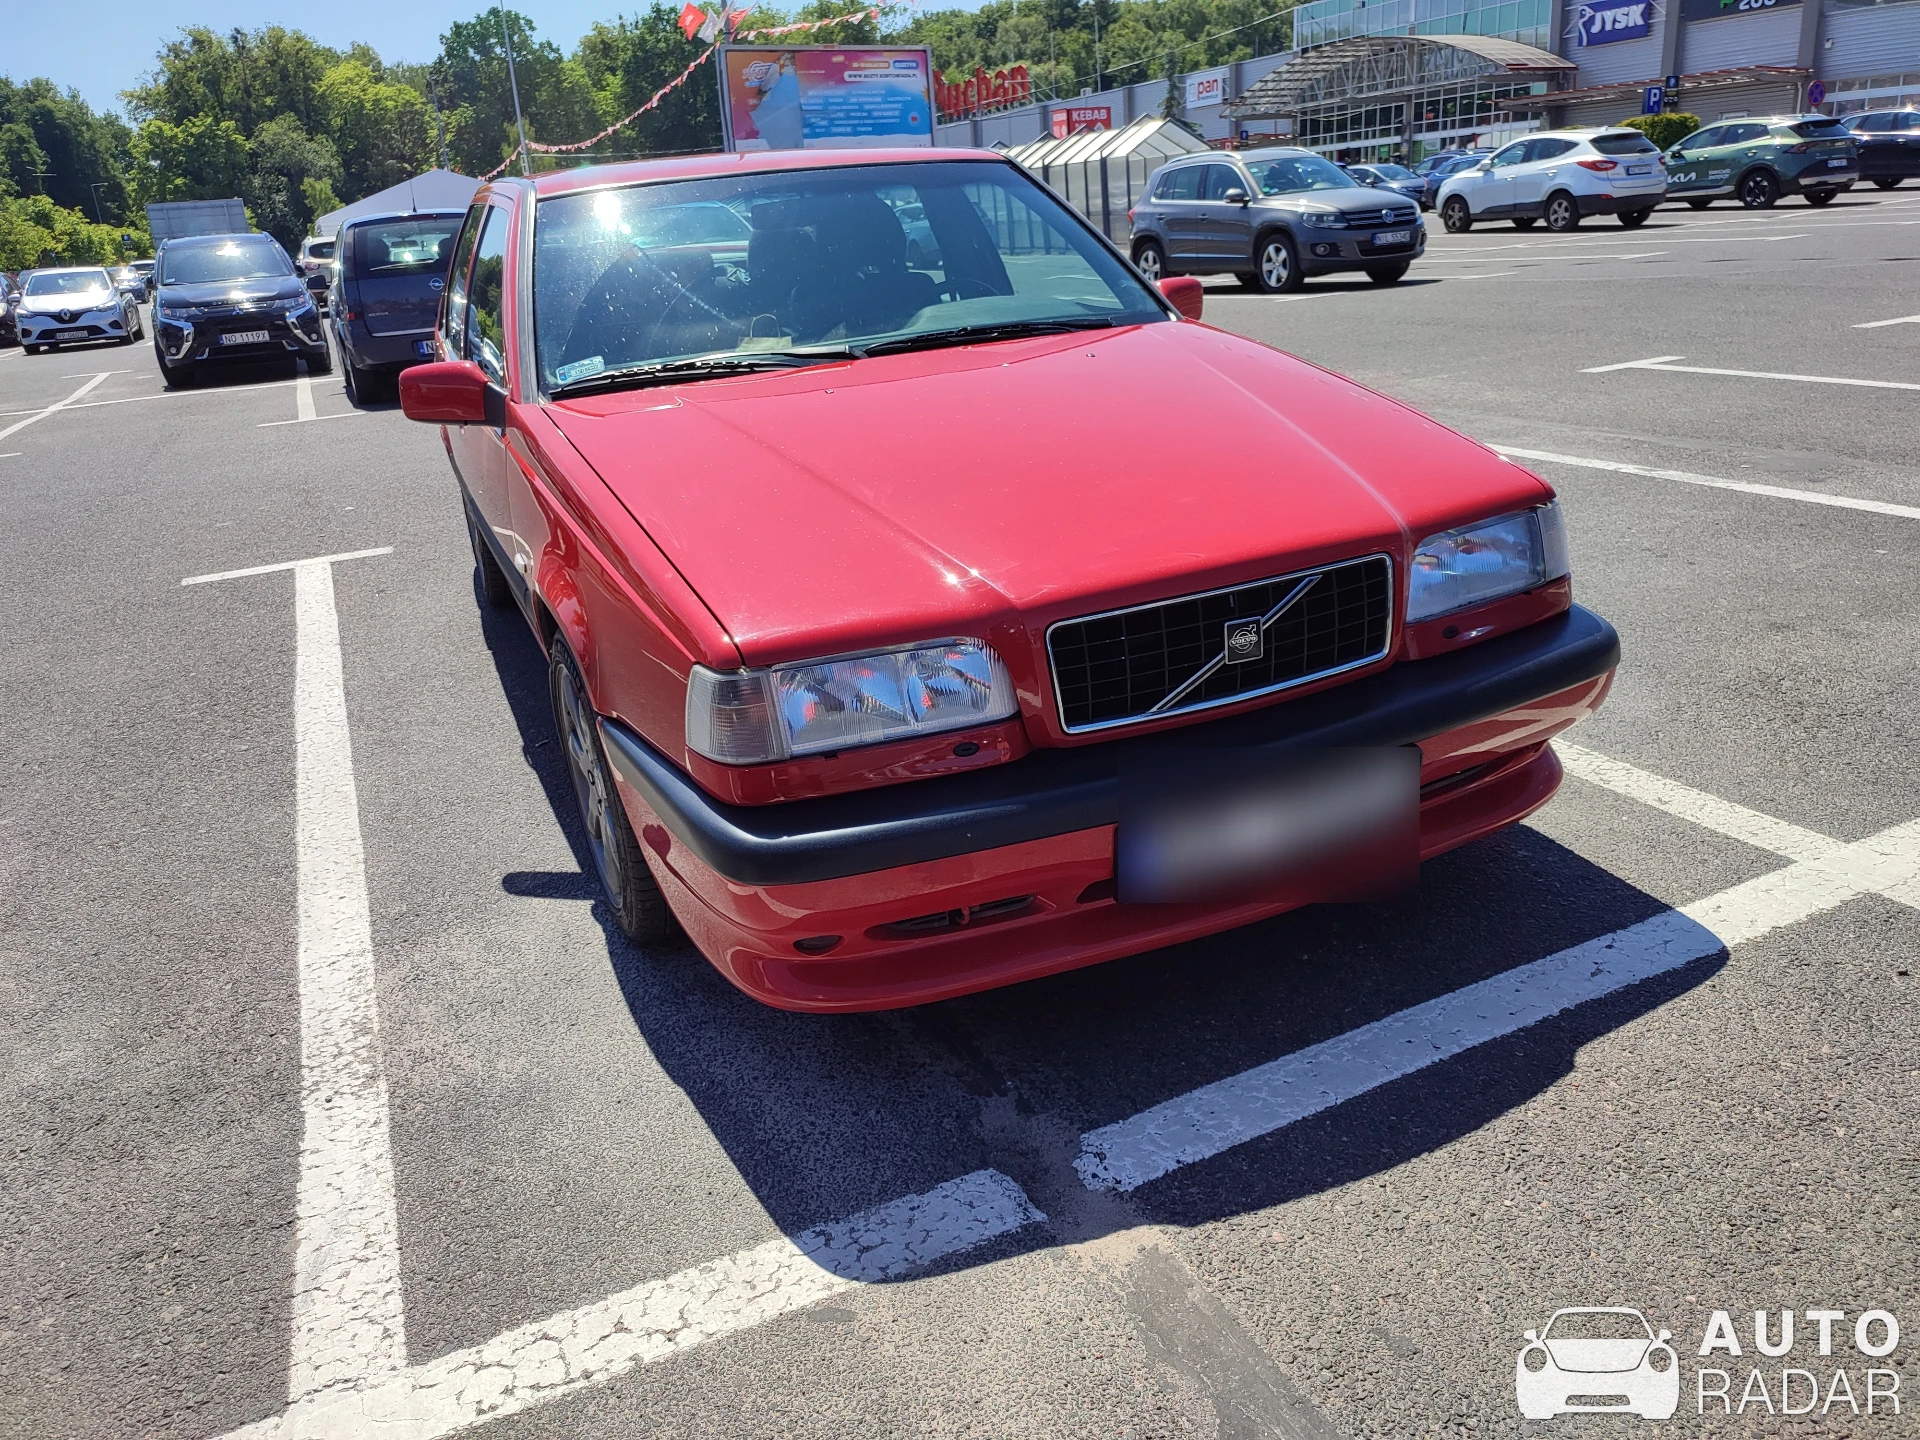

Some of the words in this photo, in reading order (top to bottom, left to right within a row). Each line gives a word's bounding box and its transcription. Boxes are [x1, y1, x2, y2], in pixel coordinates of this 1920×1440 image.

[1590, 3, 1646, 34] JYSK
[1197, 79, 1218, 101] pan
[1649, 89, 1660, 106] P
[1072, 109, 1107, 121] KEBAB
[224, 335, 237, 343] NO
[240, 331, 267, 342] 1119X
[425, 342, 435, 352] N
